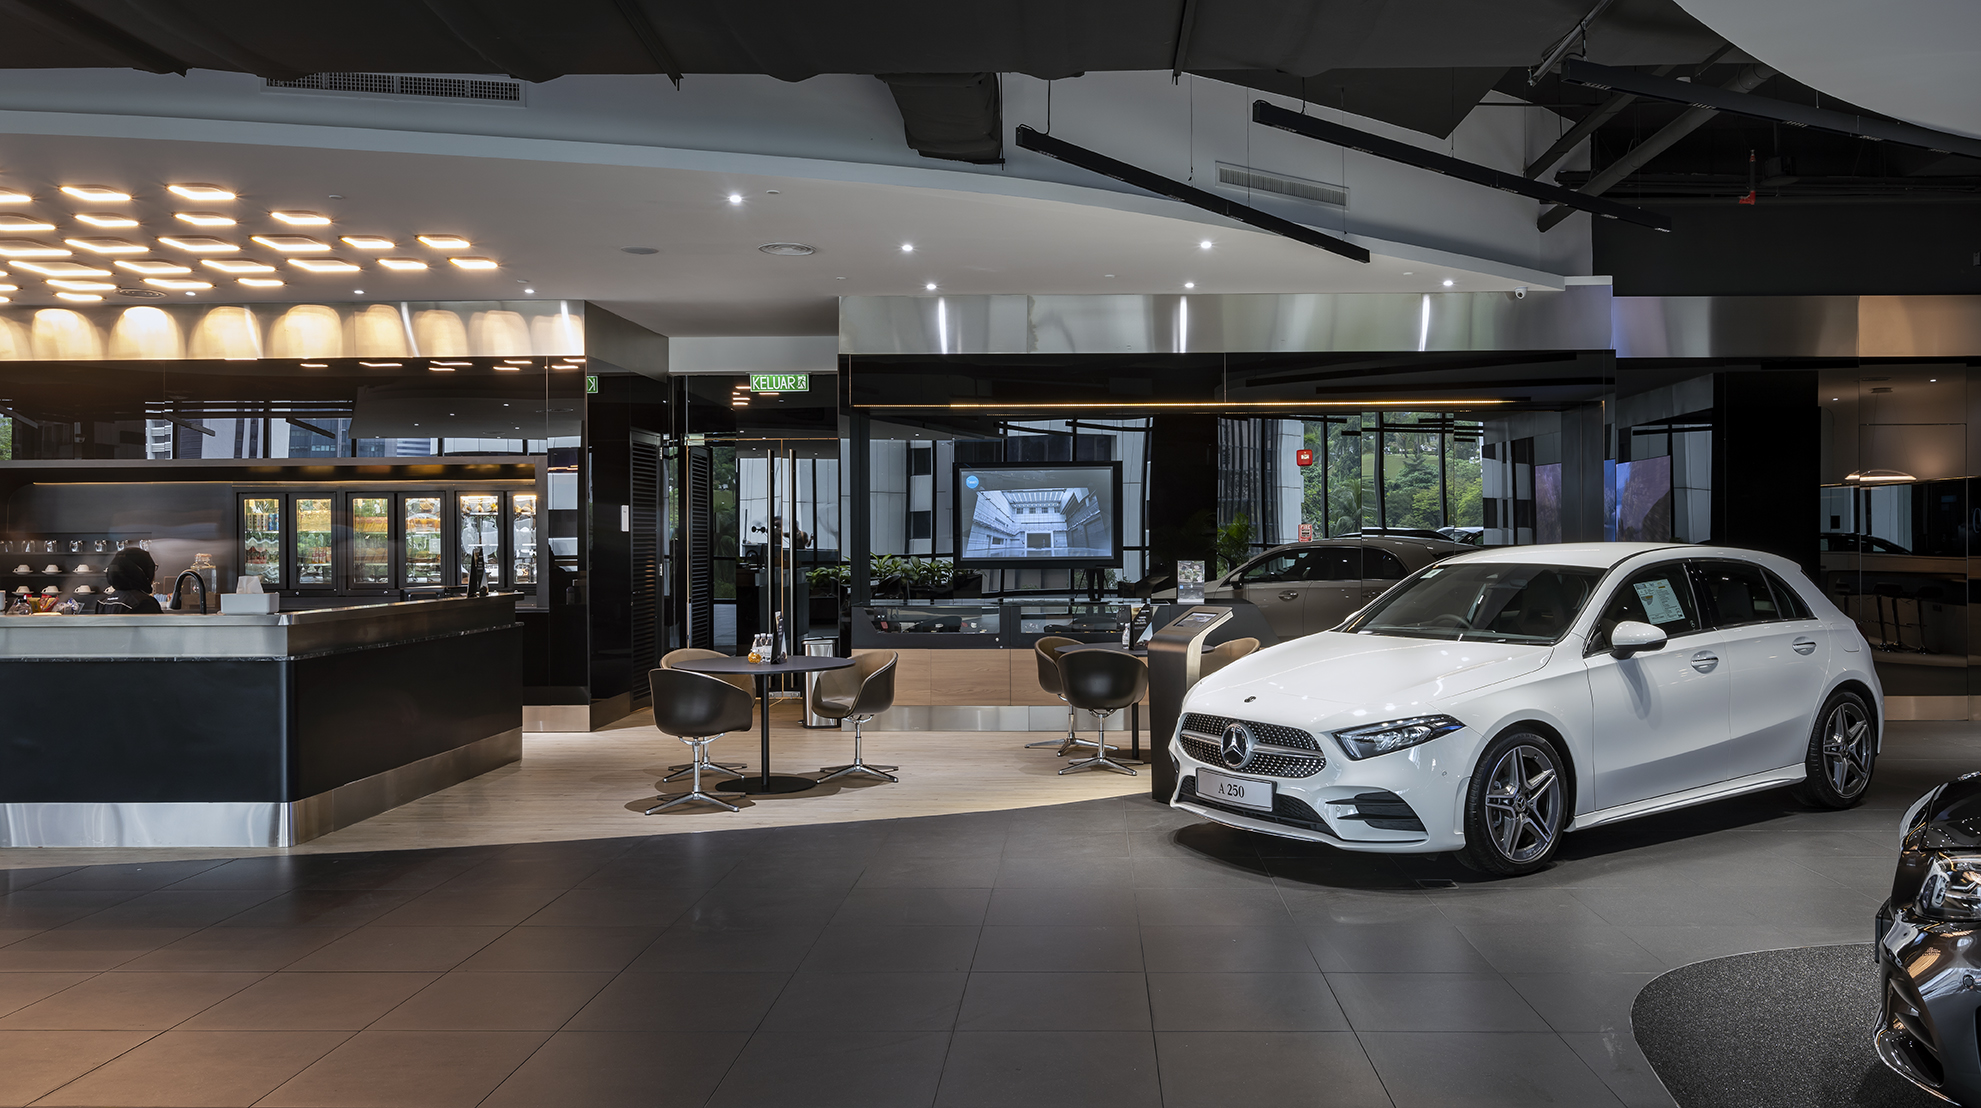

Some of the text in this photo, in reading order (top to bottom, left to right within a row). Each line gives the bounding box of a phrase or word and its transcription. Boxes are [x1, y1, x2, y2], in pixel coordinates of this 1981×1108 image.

[752, 376, 796, 390] KELUAR
[1218, 782, 1245, 798] A 250
